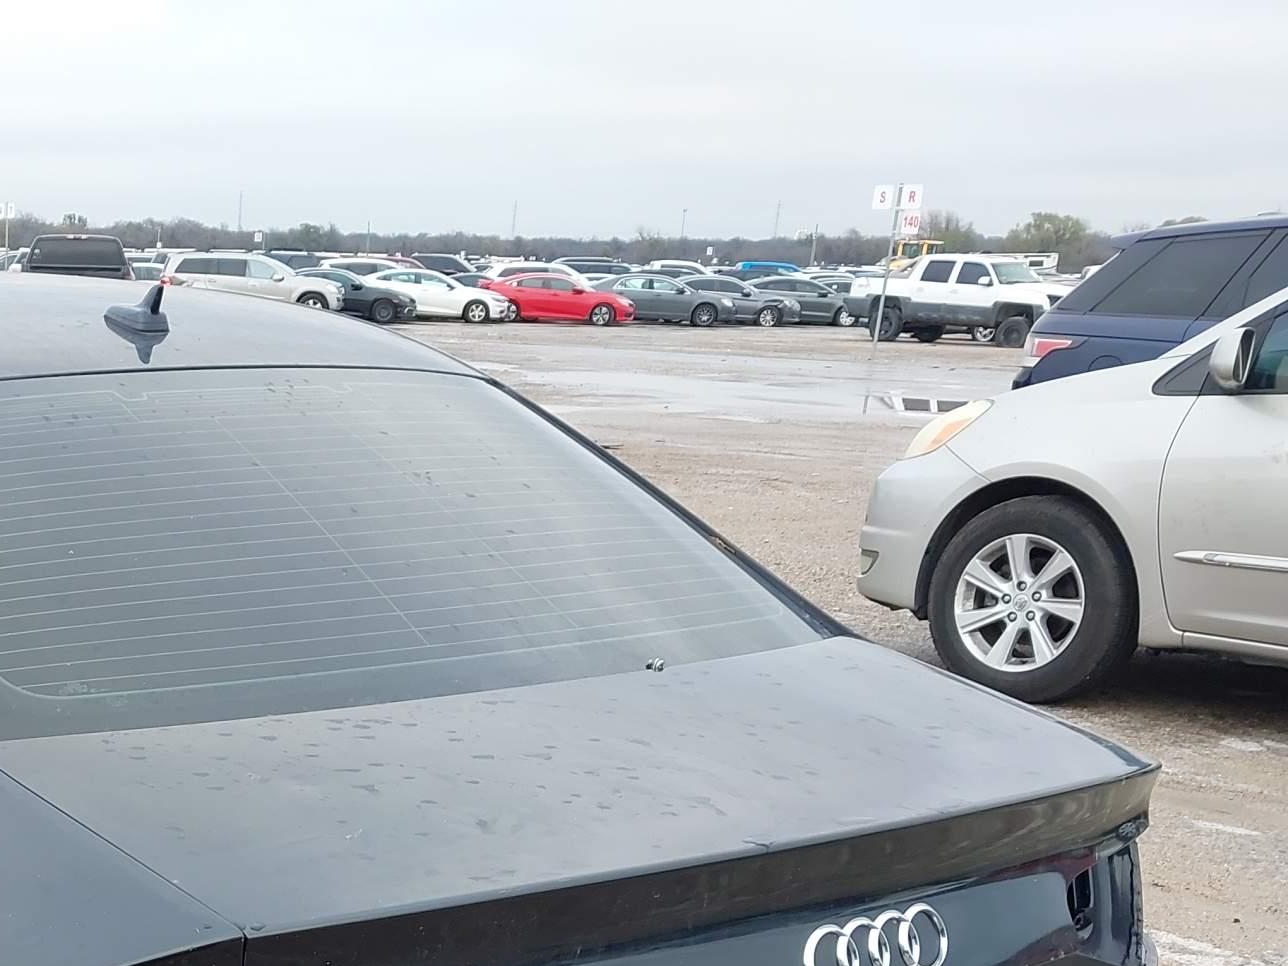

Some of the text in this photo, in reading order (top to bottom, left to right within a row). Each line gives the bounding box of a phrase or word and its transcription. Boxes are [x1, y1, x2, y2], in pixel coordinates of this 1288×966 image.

[879, 191, 886, 203] S
[908, 190, 916, 203] R
[903, 215, 919, 228] 140
